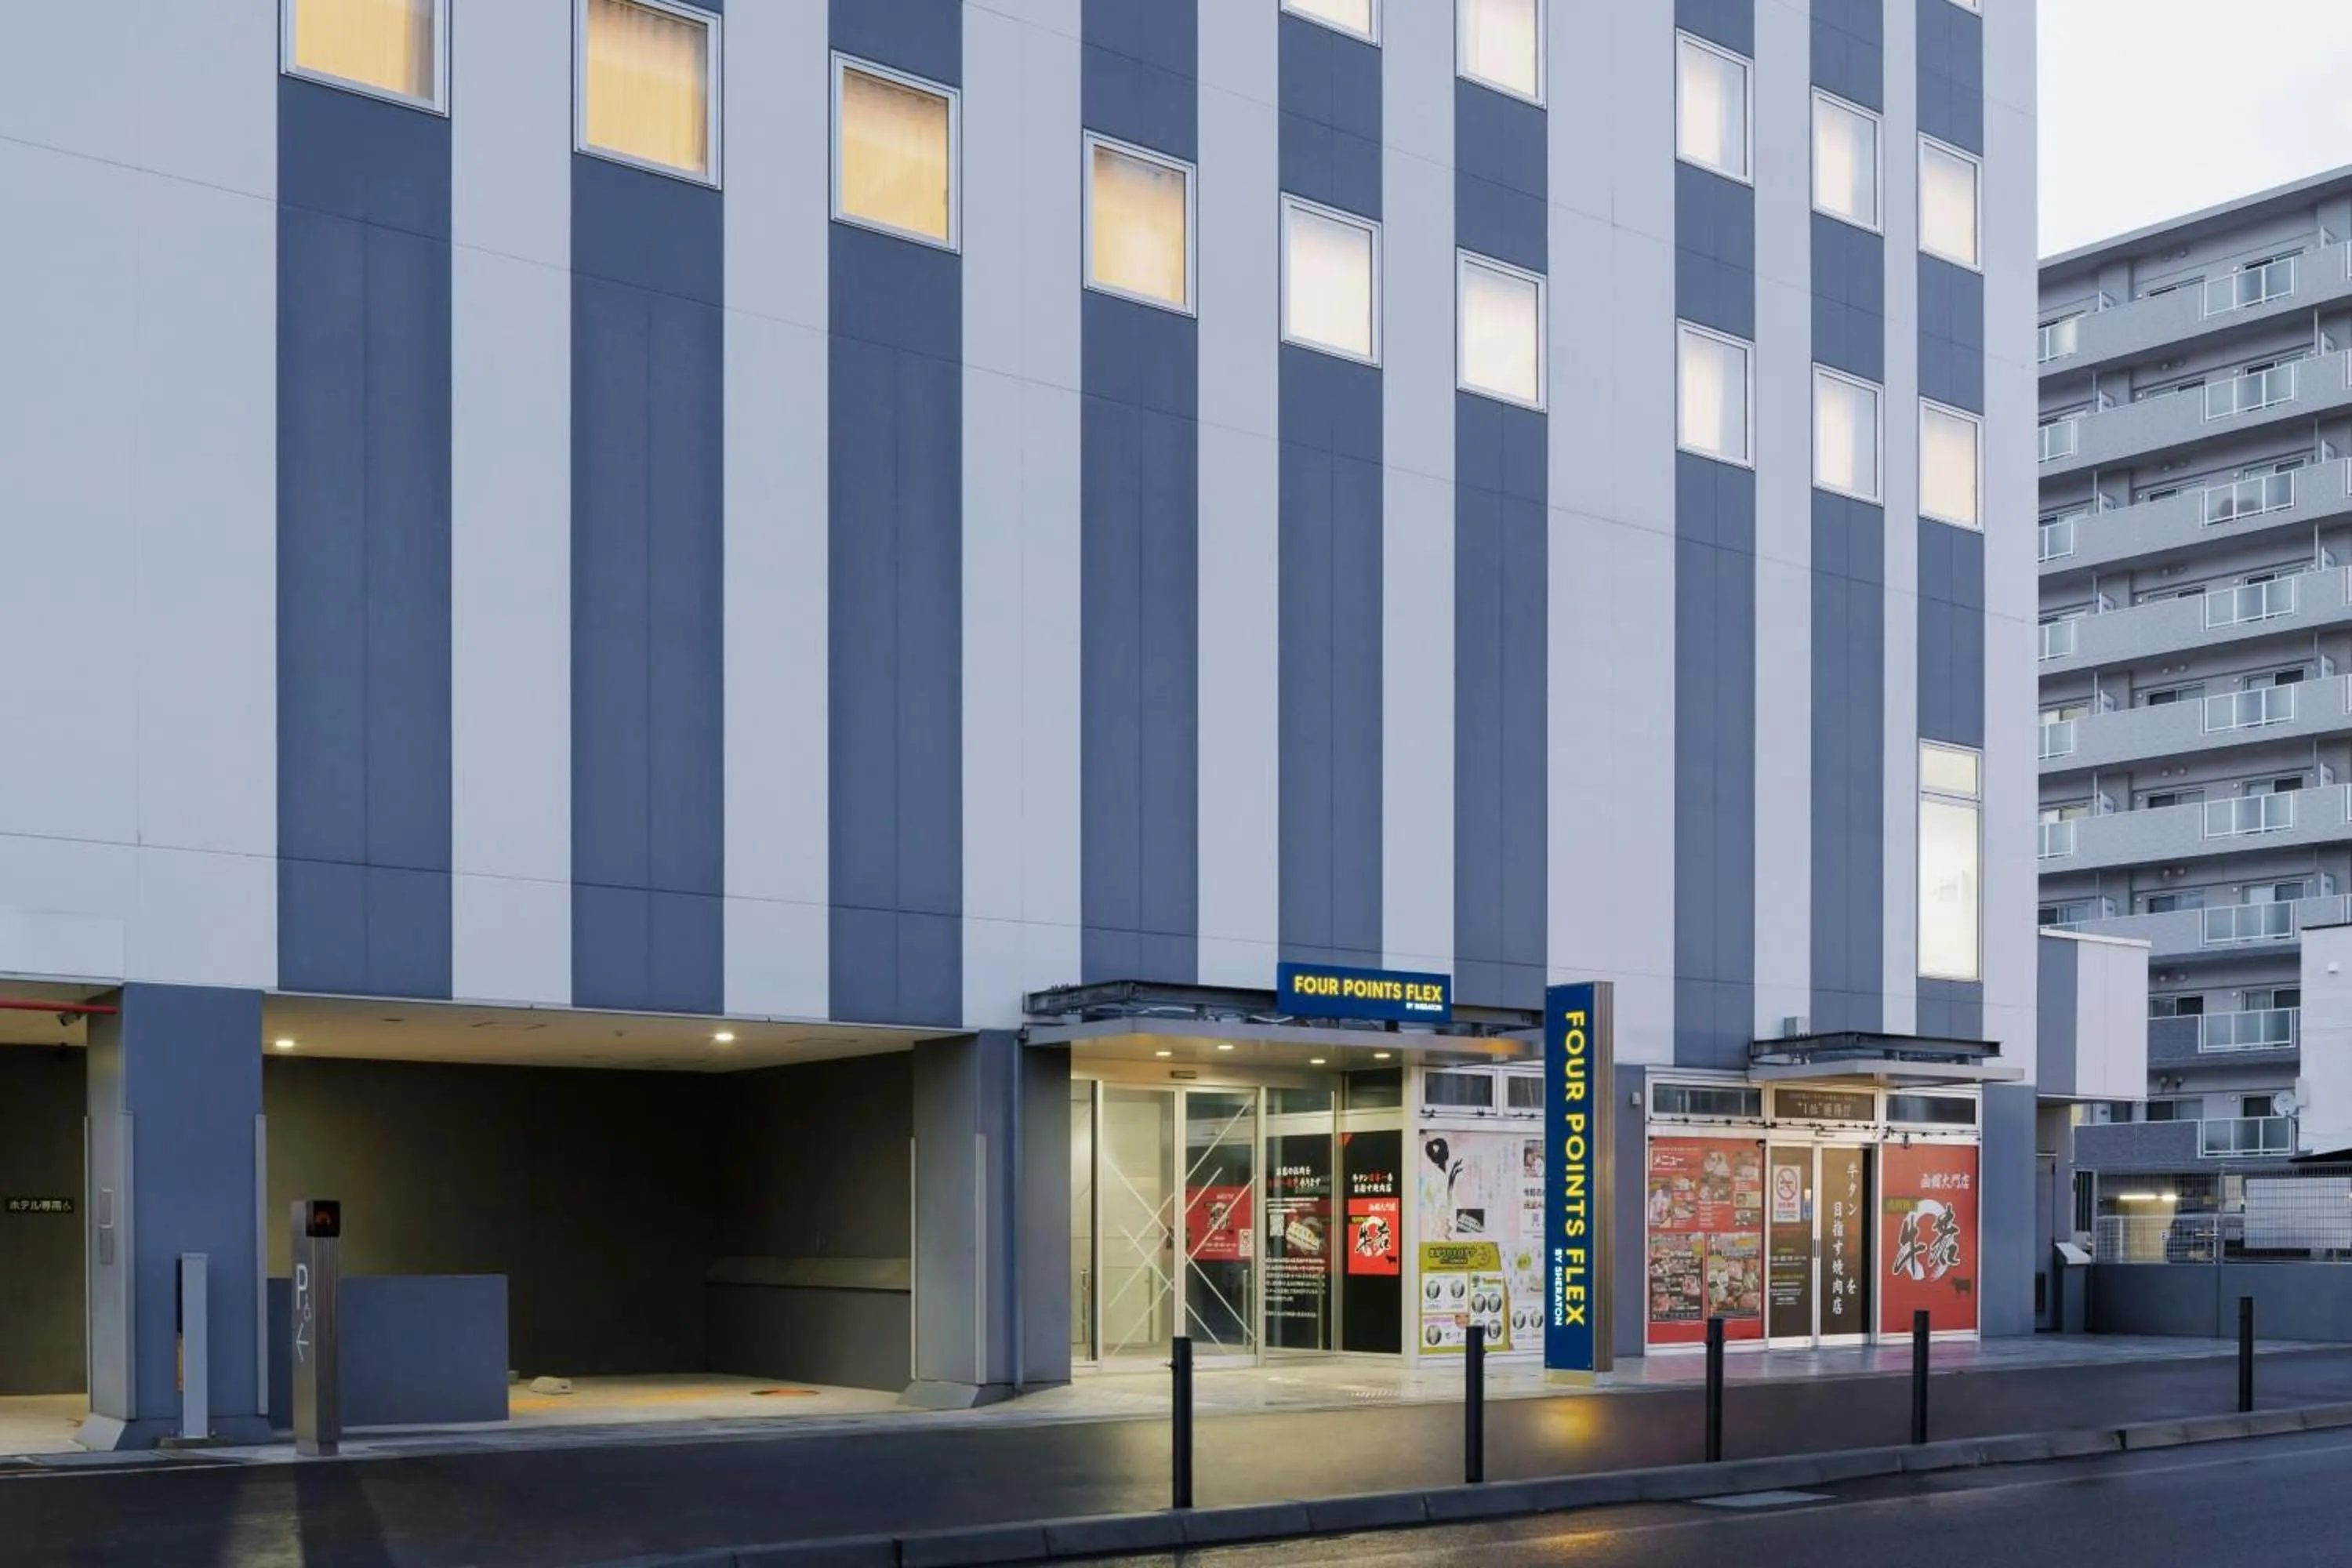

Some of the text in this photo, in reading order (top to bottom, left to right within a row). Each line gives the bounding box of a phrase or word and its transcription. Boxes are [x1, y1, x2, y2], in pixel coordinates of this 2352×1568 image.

[1294, 975, 1443, 1002] FOUR POINTS FLEX
[1566, 1011, 1585, 1326] FOUR POINTS FLEX
[1653, 1154, 1685, 1166] メニュー
[1555, 1249, 1563, 1263] BY
[1832, 1201, 1844, 1315] 目指す焼肉店
[296, 1263, 308, 1310] P
